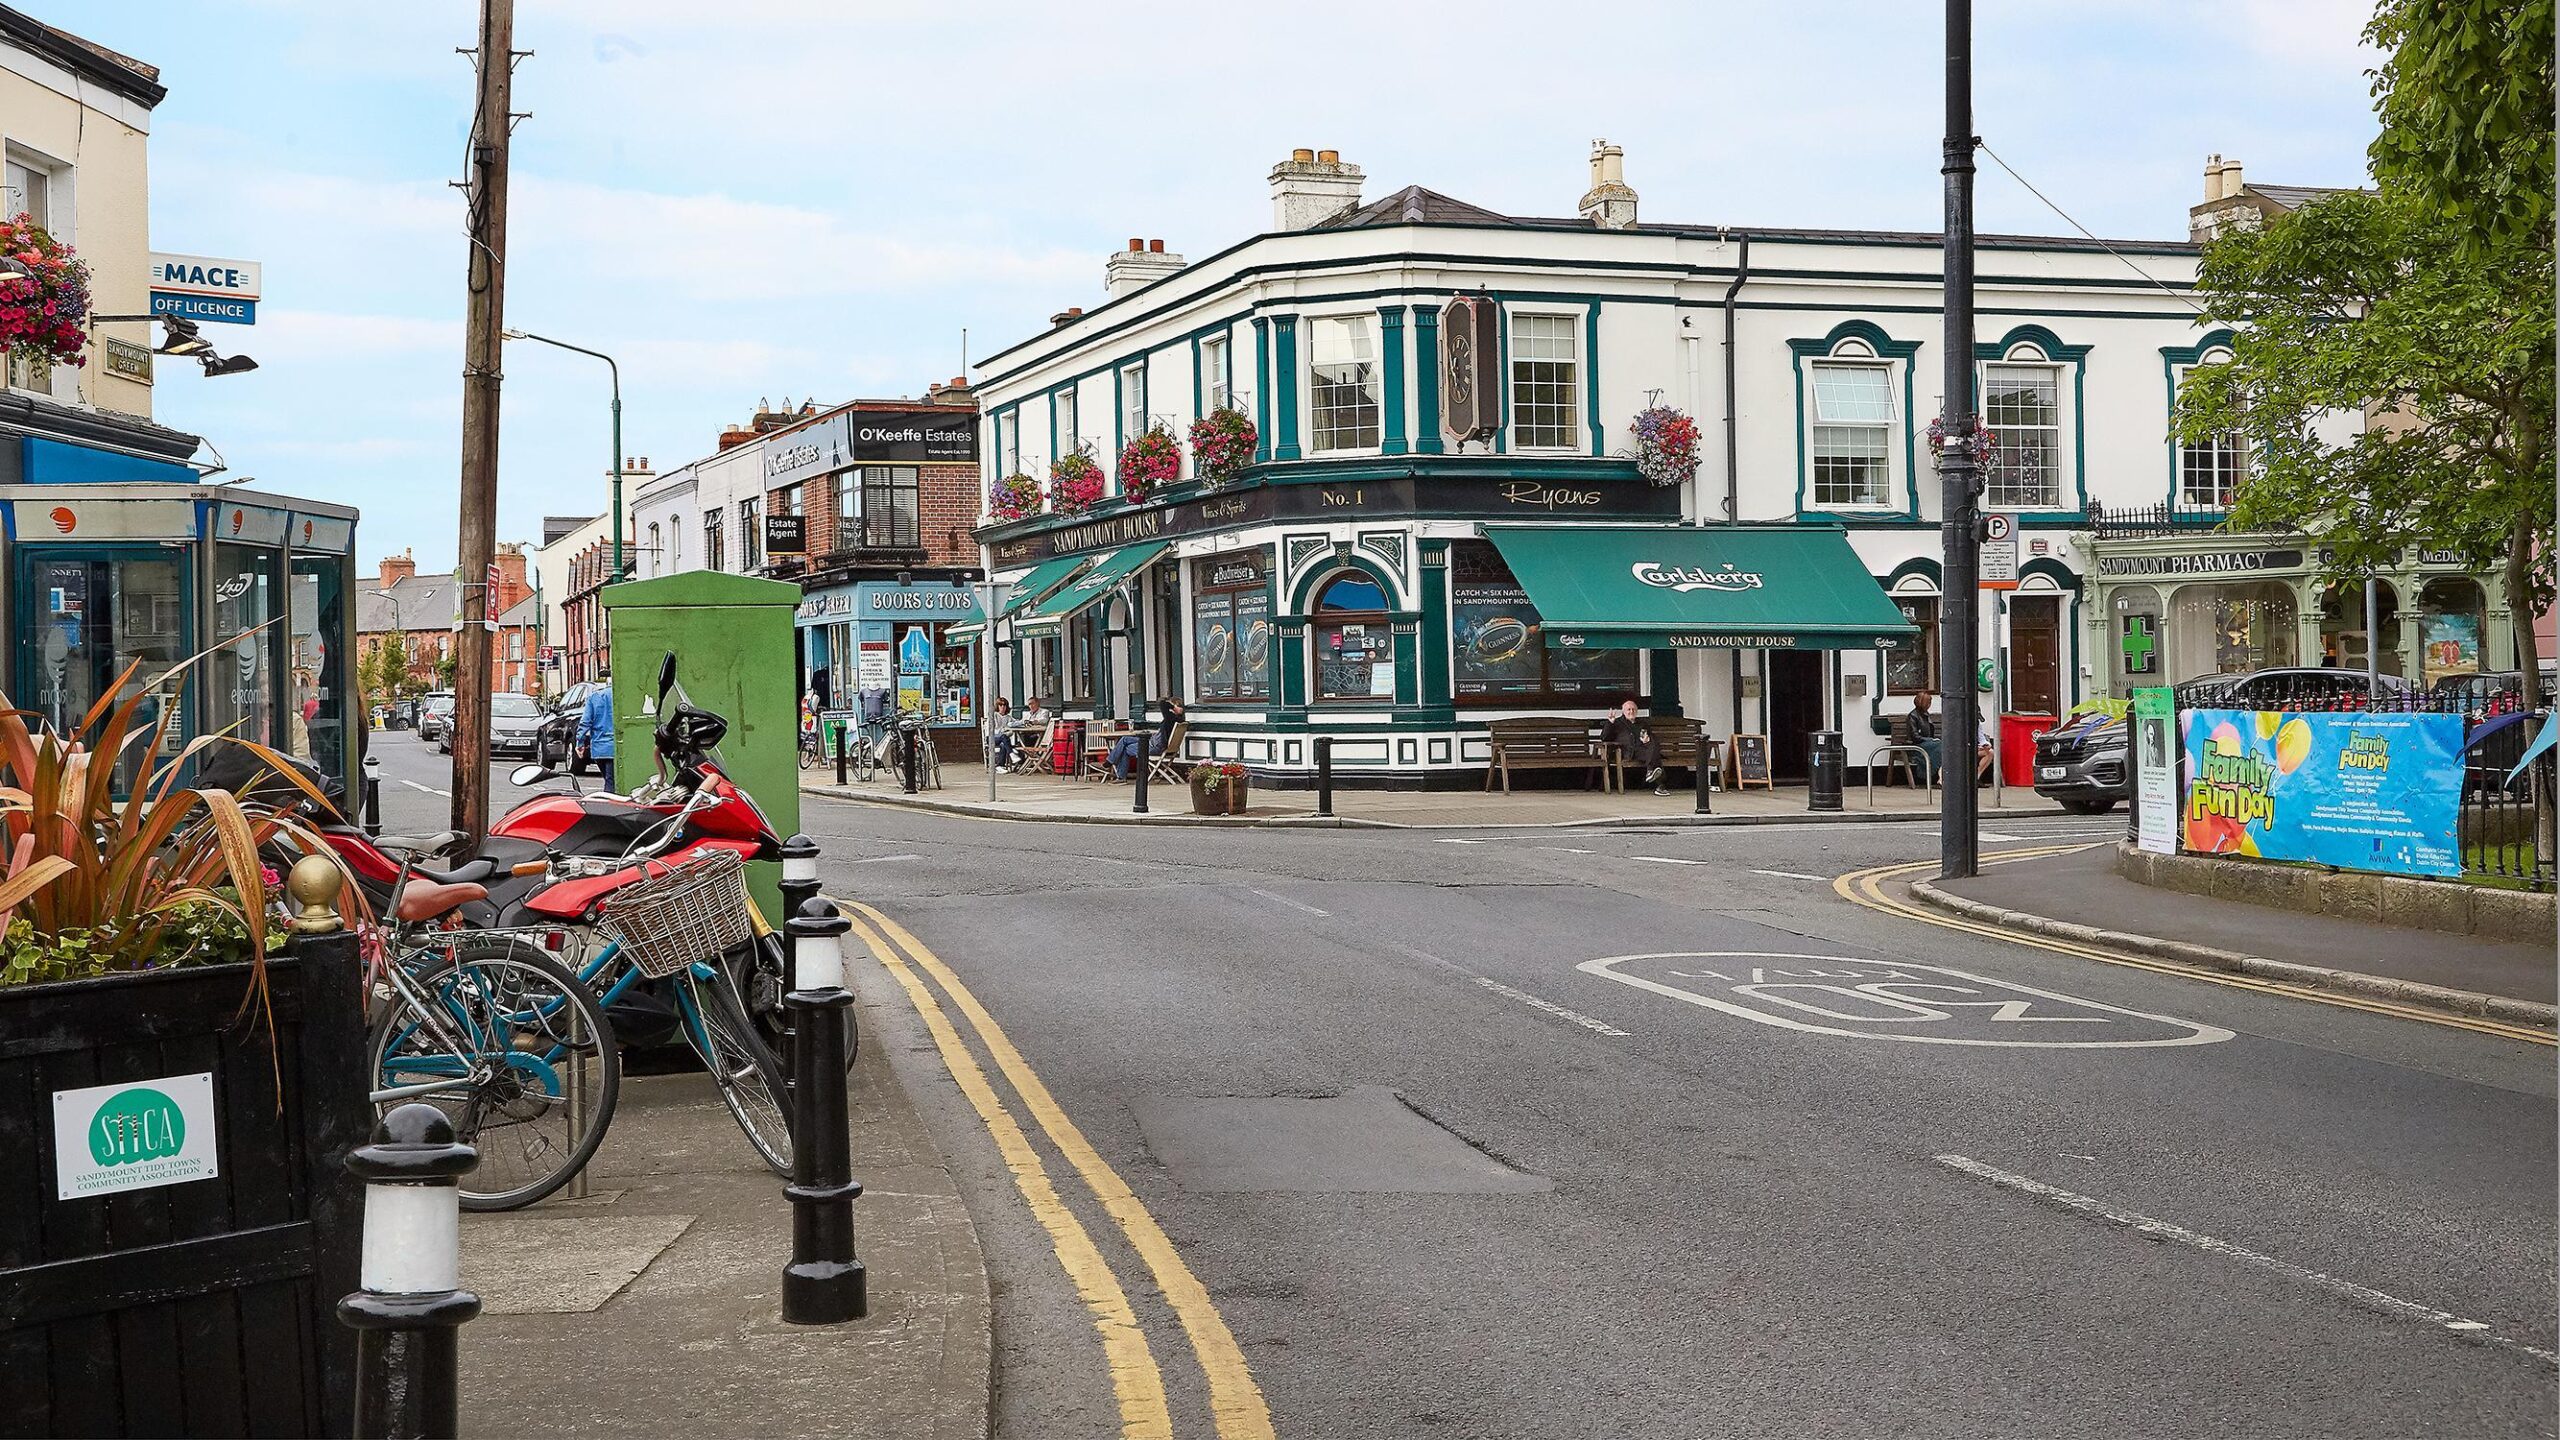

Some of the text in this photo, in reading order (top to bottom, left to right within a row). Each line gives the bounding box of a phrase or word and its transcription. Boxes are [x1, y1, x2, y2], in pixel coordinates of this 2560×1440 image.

[165, 263, 239, 288] MACE
[155, 298, 245, 318] OFF LICENCE
[860, 428, 972, 442] O'Keeffe Estates
[1321, 490, 1364, 507] No. 1
[1499, 481, 1601, 511] Ryans
[769, 519, 797, 528] Estate
[769, 529, 797, 539] Agent
[1054, 521, 1117, 554] SANDYMOUNT
[1123, 512, 1159, 540] HOUSE
[2100, 552, 2268, 575] SANDYMOUNT PHARMACY
[1631, 561, 1763, 593] Carlsberg
[872, 592, 972, 610] BOOKS & TOYS
[1488, 631, 1520, 649] GUINNESS
[1670, 636, 1795, 646] SANDYMOUNT HOUSE
[2349, 730, 2389, 756] Family
[2201, 738, 2276, 795] Family
[2338, 749, 2390, 773] Fun Day
[2192, 778, 2237, 821] Fun
[2237, 785, 2275, 831] Day
[2369, 853, 2392, 864] AVIVA
[1730, 983, 2112, 1023] 30
[76, 1157, 201, 1183] SANDYMOUNT TIDY TOWNS
[77, 1167, 200, 1191] COMMUNITY ASSOCIATION
